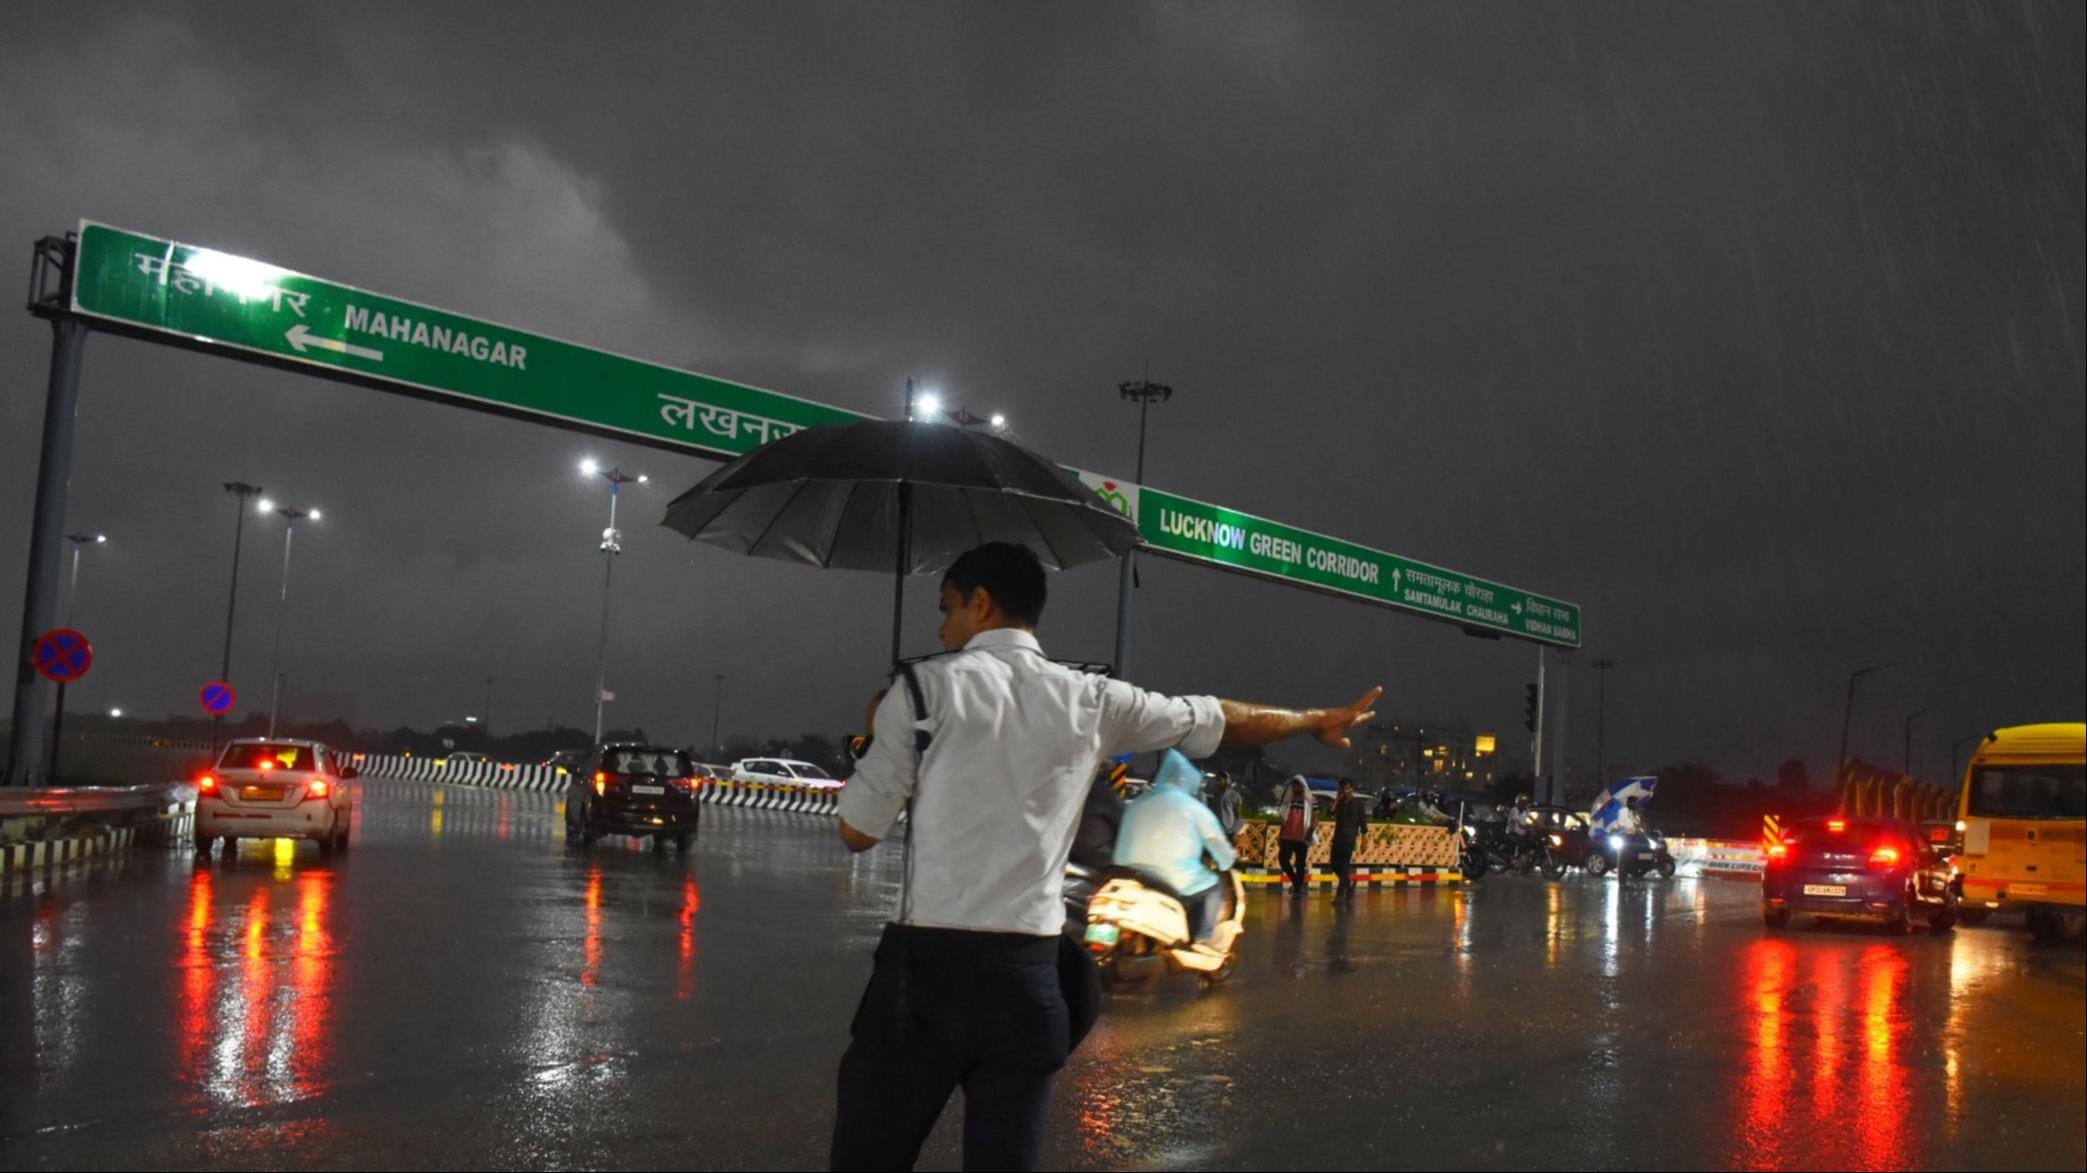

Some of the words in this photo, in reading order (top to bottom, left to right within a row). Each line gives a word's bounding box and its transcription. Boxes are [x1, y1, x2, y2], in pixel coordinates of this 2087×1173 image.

[135, 252, 311, 317] महार
[345, 304, 527, 370] MAHANAGAR
[1160, 508, 1246, 550] LUCKNOW
[1250, 531, 1301, 565] GREEN
[1307, 547, 1379, 584] CORRIDOR
[1404, 588, 1462, 614] SAMTAMULAK
[1466, 603, 1509, 625] CHAURAHA
[1525, 619, 1552, 635] VIDHAN
[1553, 625, 1576, 640] SABHA
